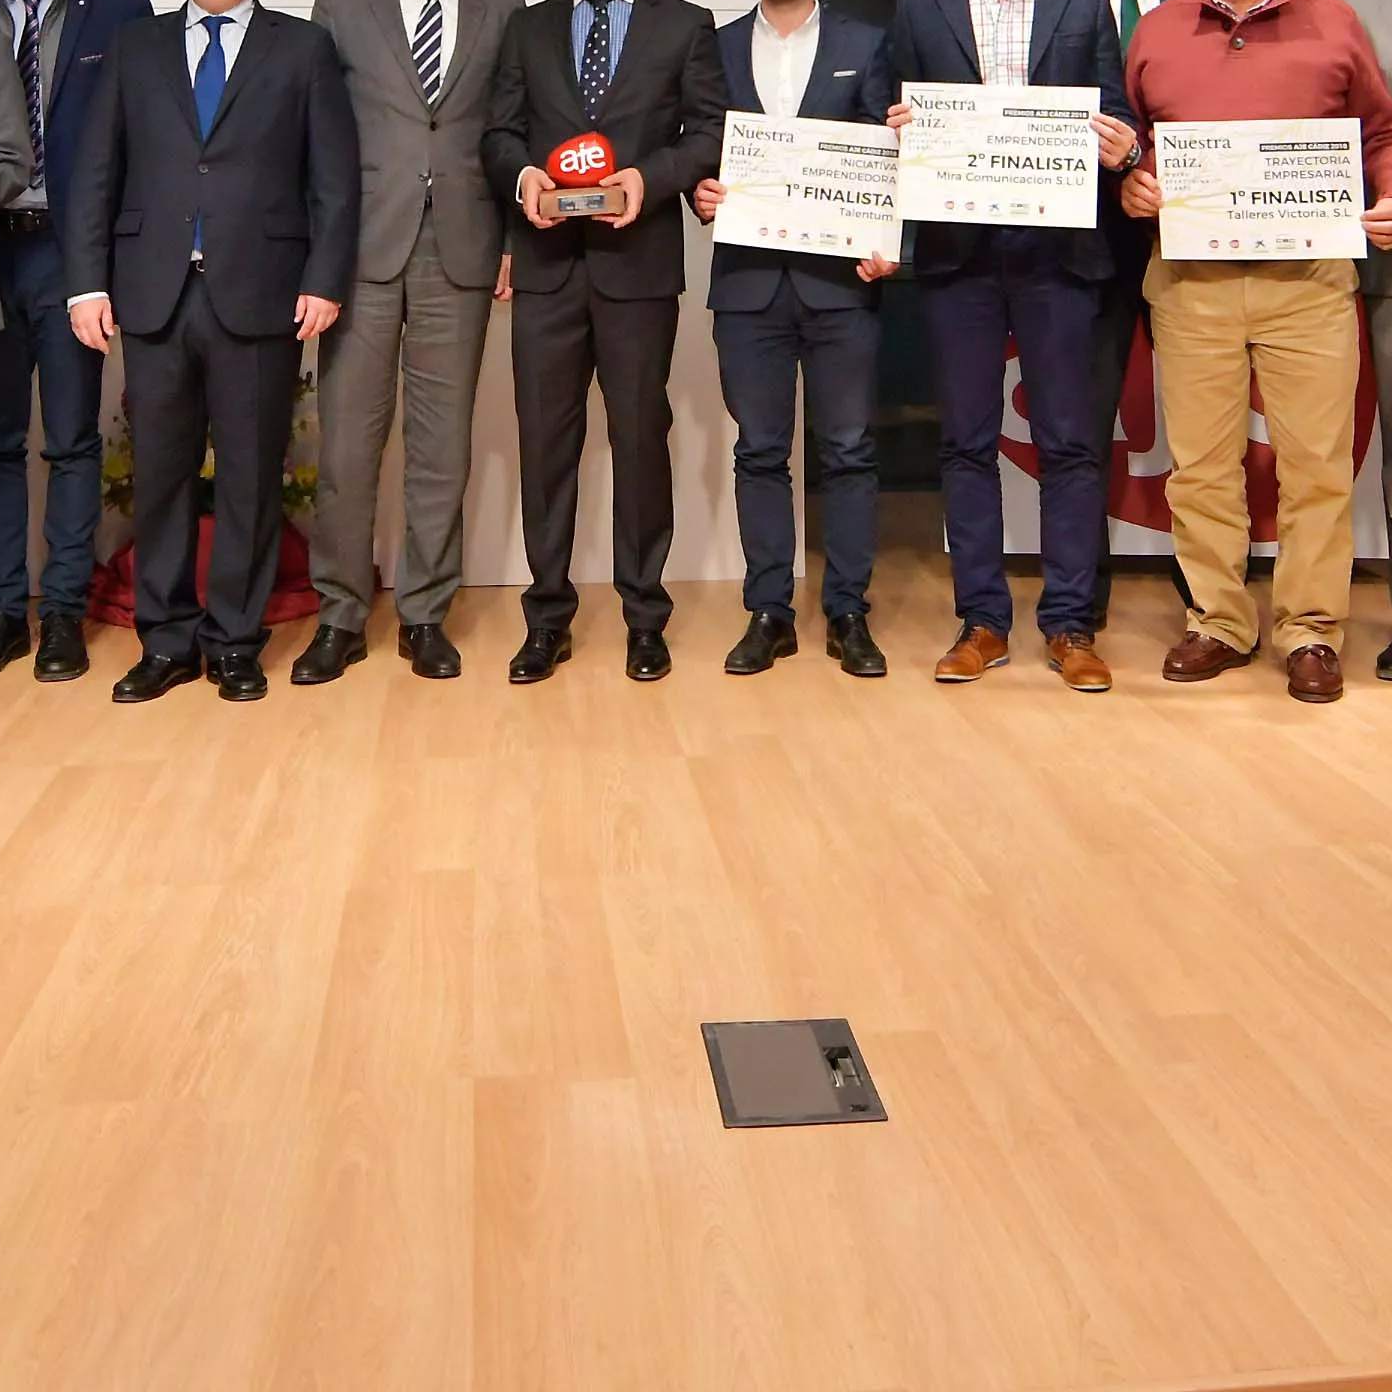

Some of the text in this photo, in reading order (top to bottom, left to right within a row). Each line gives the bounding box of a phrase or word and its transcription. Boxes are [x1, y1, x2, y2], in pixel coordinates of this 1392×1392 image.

[909, 94, 977, 111] Nuestra
[731, 124, 795, 143] Nuestra
[1028, 123, 1088, 134] INICIATIVA
[987, 135, 1088, 148] EMPRENDEDORA
[1163, 135, 1231, 150] Nuestra
[559, 142, 606, 174] aje
[729, 143, 765, 158] raíz.
[840, 158, 898, 171] INICIATIVA
[991, 155, 1087, 172] FINALISTA
[1164, 154, 1202, 169] raíz.
[1264, 156, 1350, 166] TRAYECTORIA
[802, 167, 897, 185] EMPRENDEDORA
[937, 171, 962, 181] Mira
[1264, 170, 1351, 180] EMPRESARIAL
[804, 187, 895, 208] FINALISTA
[1251, 190, 1352, 205] FINALISTA
[840, 207, 894, 221] Talentum
[1227, 209, 1274, 220] Talleres
